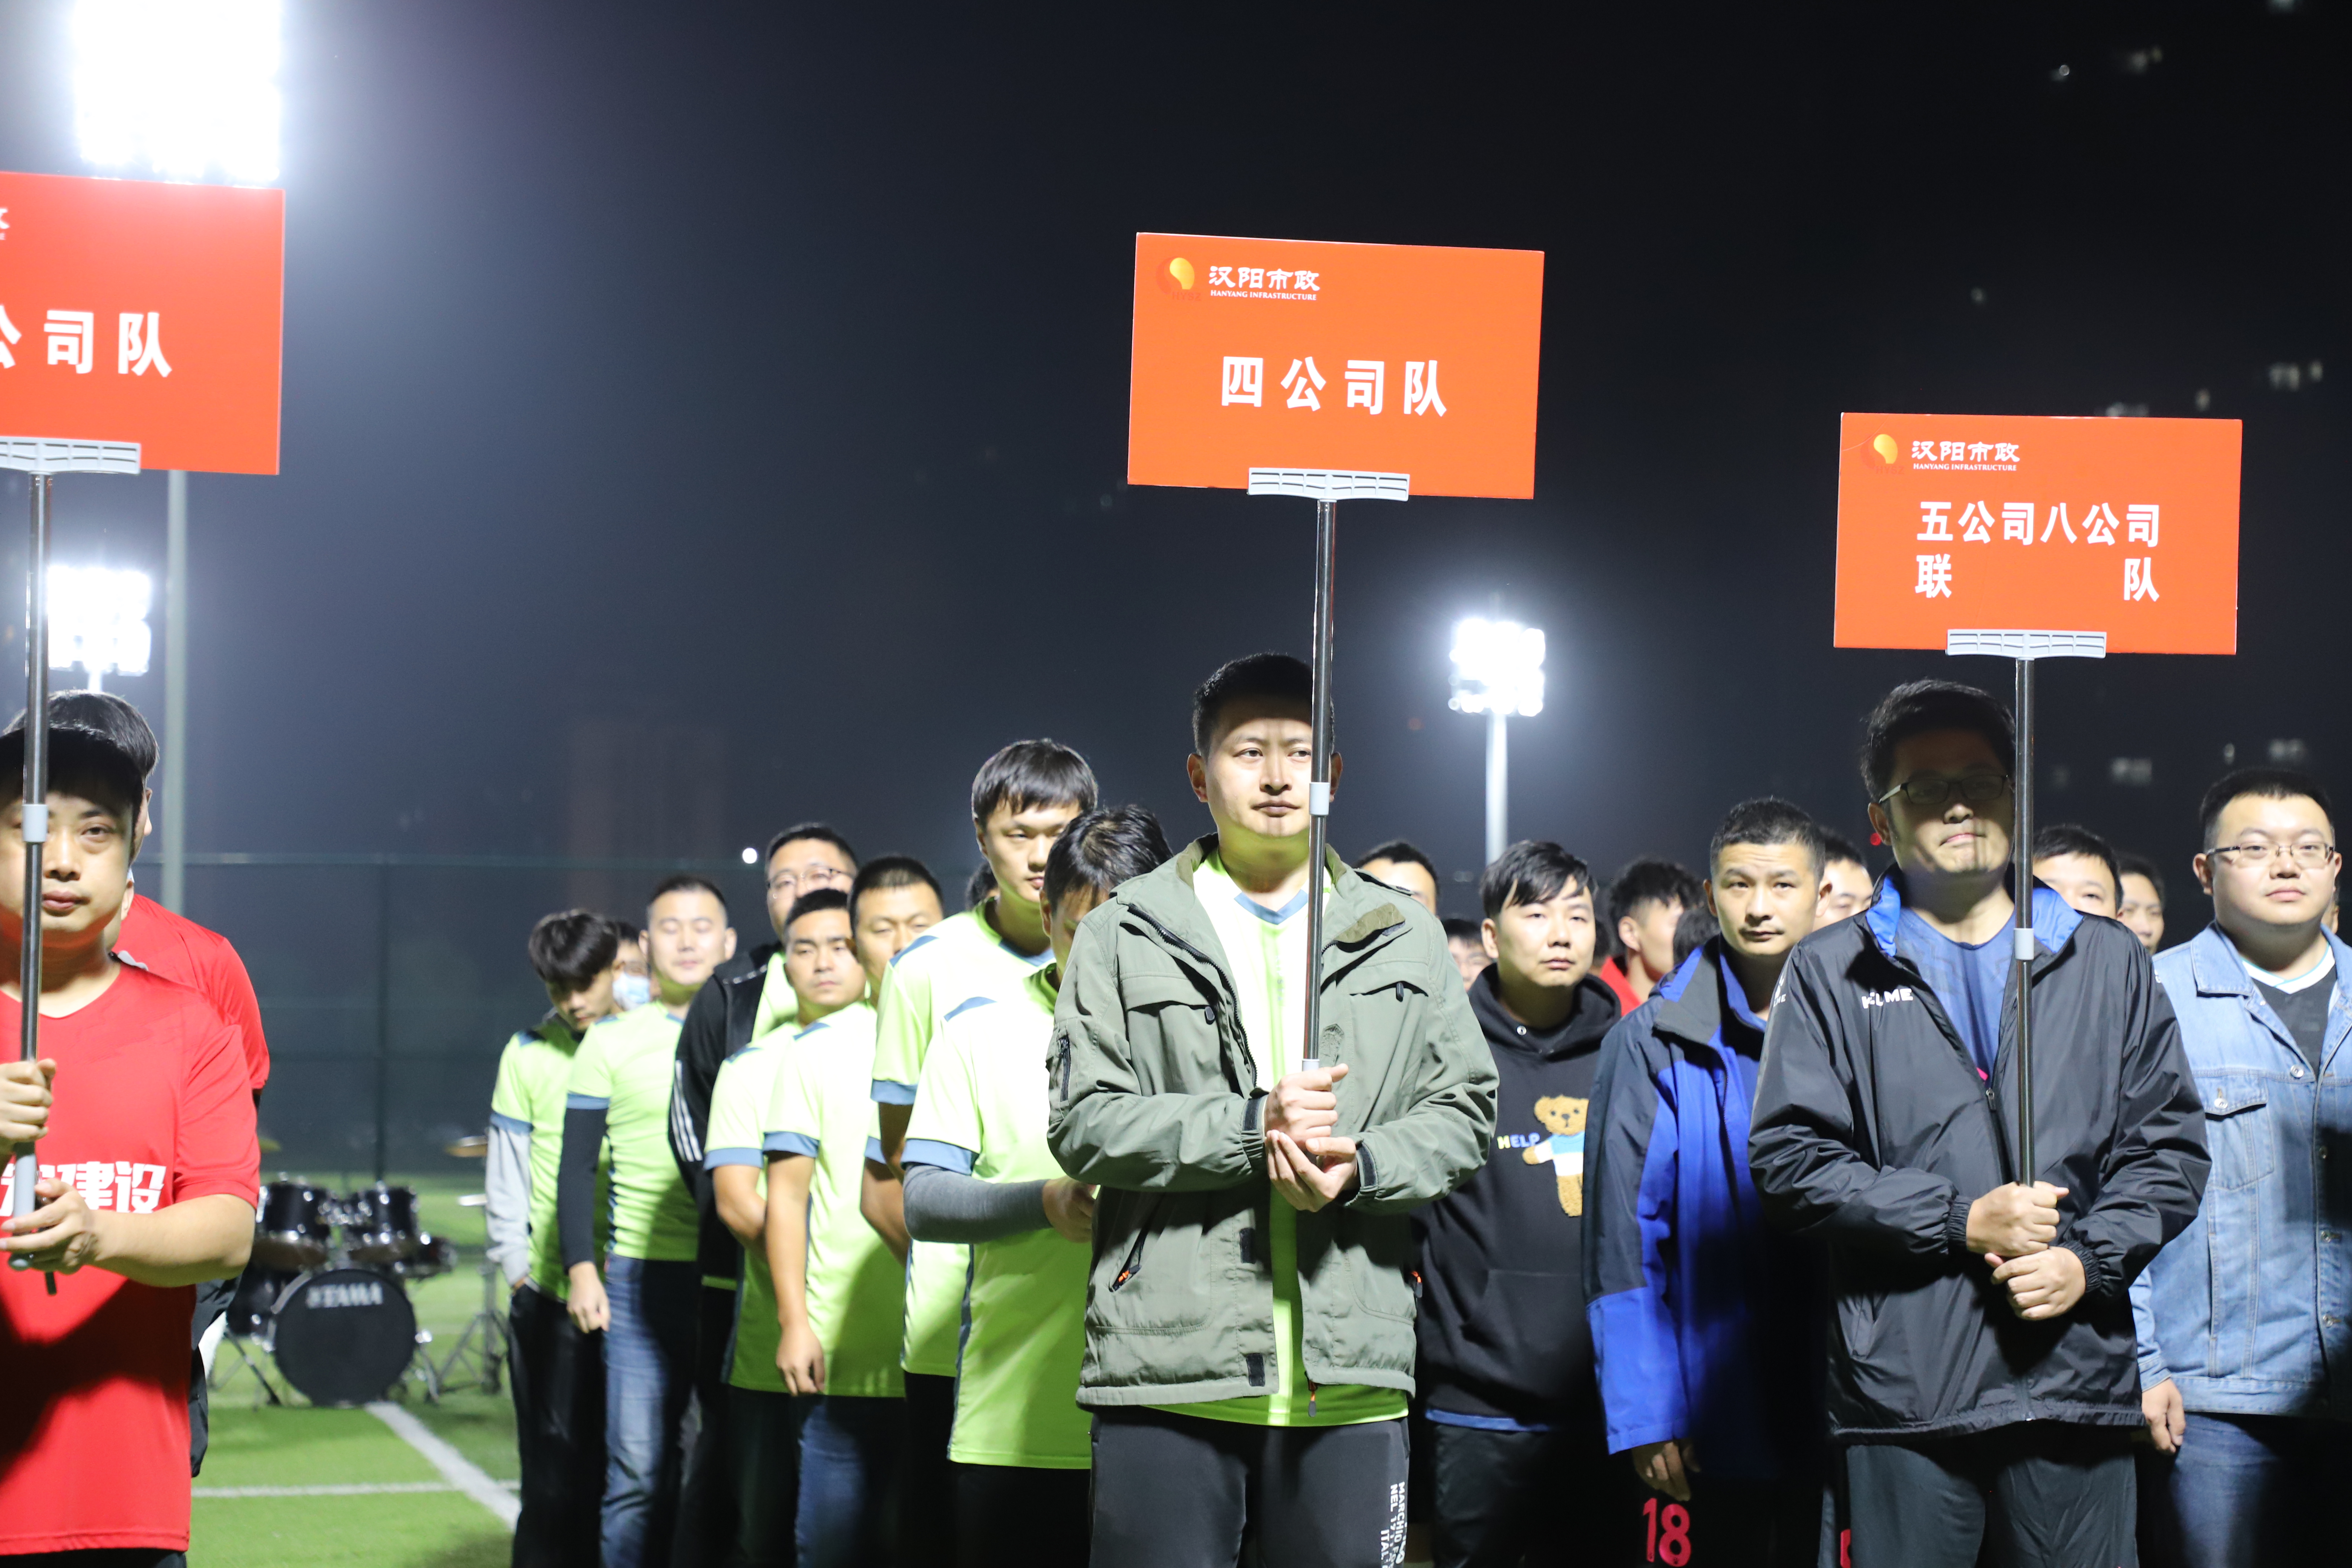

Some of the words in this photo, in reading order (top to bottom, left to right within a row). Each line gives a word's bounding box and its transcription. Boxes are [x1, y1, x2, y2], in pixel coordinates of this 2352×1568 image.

[1209, 266, 1320, 291] 汉阳市政
[1250, 291, 1317, 300] INFRASTRUCTURE
[1221, 356, 1447, 416] 四公司队
[1912, 441, 2020, 462] 汉阳市政
[1917, 501, 2159, 548] 五公司八公司
[1861, 988, 1914, 1009] KELME
[1497, 1132, 1540, 1150] HELP
[1394, 1481, 1405, 1543] MARCHIO
[1643, 1498, 1692, 1567] 18
